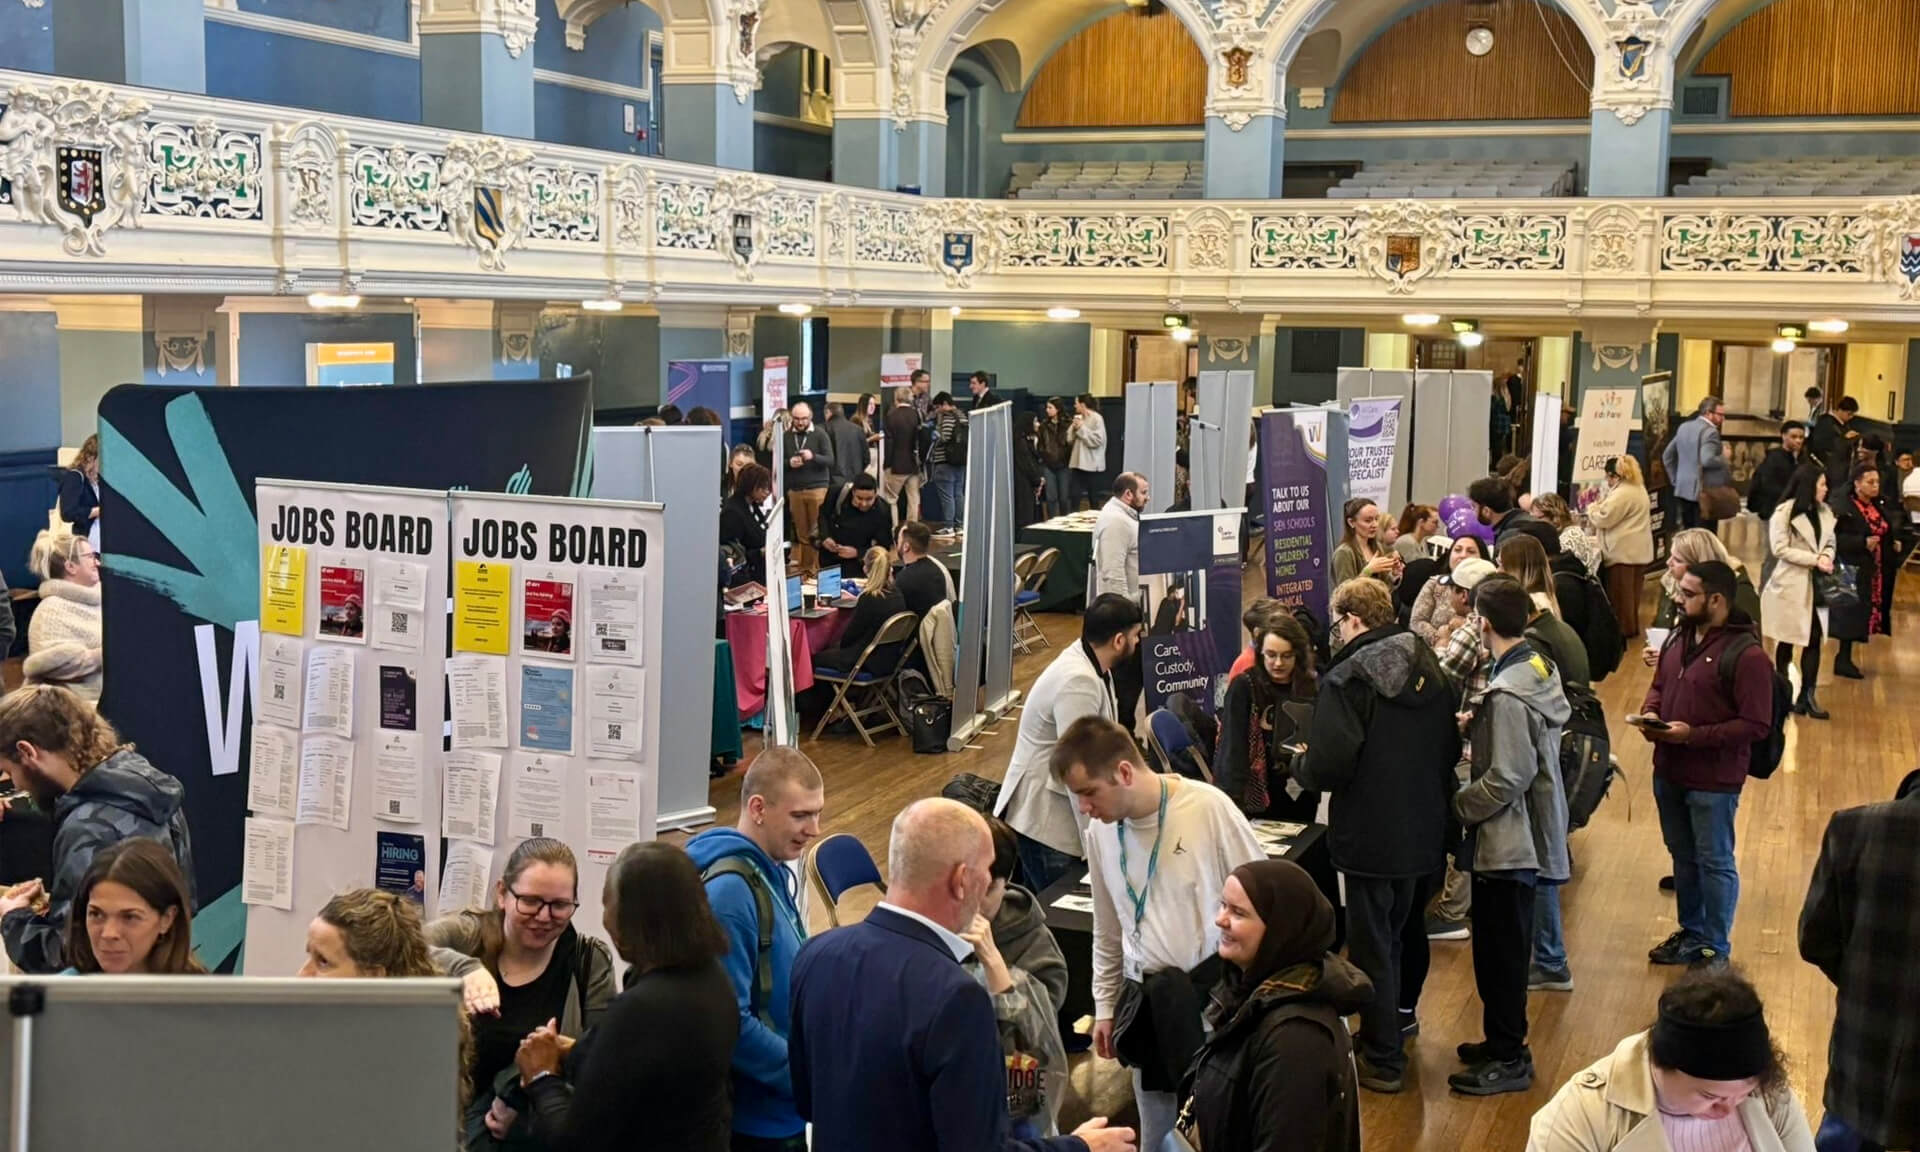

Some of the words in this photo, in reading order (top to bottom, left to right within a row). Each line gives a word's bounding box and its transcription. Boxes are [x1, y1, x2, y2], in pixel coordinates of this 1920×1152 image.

[1348, 447, 1364, 458] OUR
[1371, 457, 1390, 468] CARE
[1272, 487, 1288, 499] TALK
[1289, 486, 1300, 497] TO
[1300, 485, 1310, 497] US
[1272, 500, 1295, 513] ABOUT
[1295, 499, 1310, 511] OUR
[272, 504, 335, 547] JOBS
[345, 510, 433, 556] BOARD
[1287, 516, 1316, 530] SCHOOLS
[463, 518, 538, 561] JOBS
[549, 523, 647, 568] BOARD
[1274, 535, 1312, 550] RESIDENTIAL
[1275, 564, 1297, 577] HOMES
[1276, 579, 1313, 596] INTEGRATED
[1154, 643, 1181, 657] Care,
[1155, 659, 1196, 676] Custody,
[1156, 675, 1209, 694] Community
[381, 846, 419, 861] HIRING
[1008, 1068, 1048, 1090] IDGE
